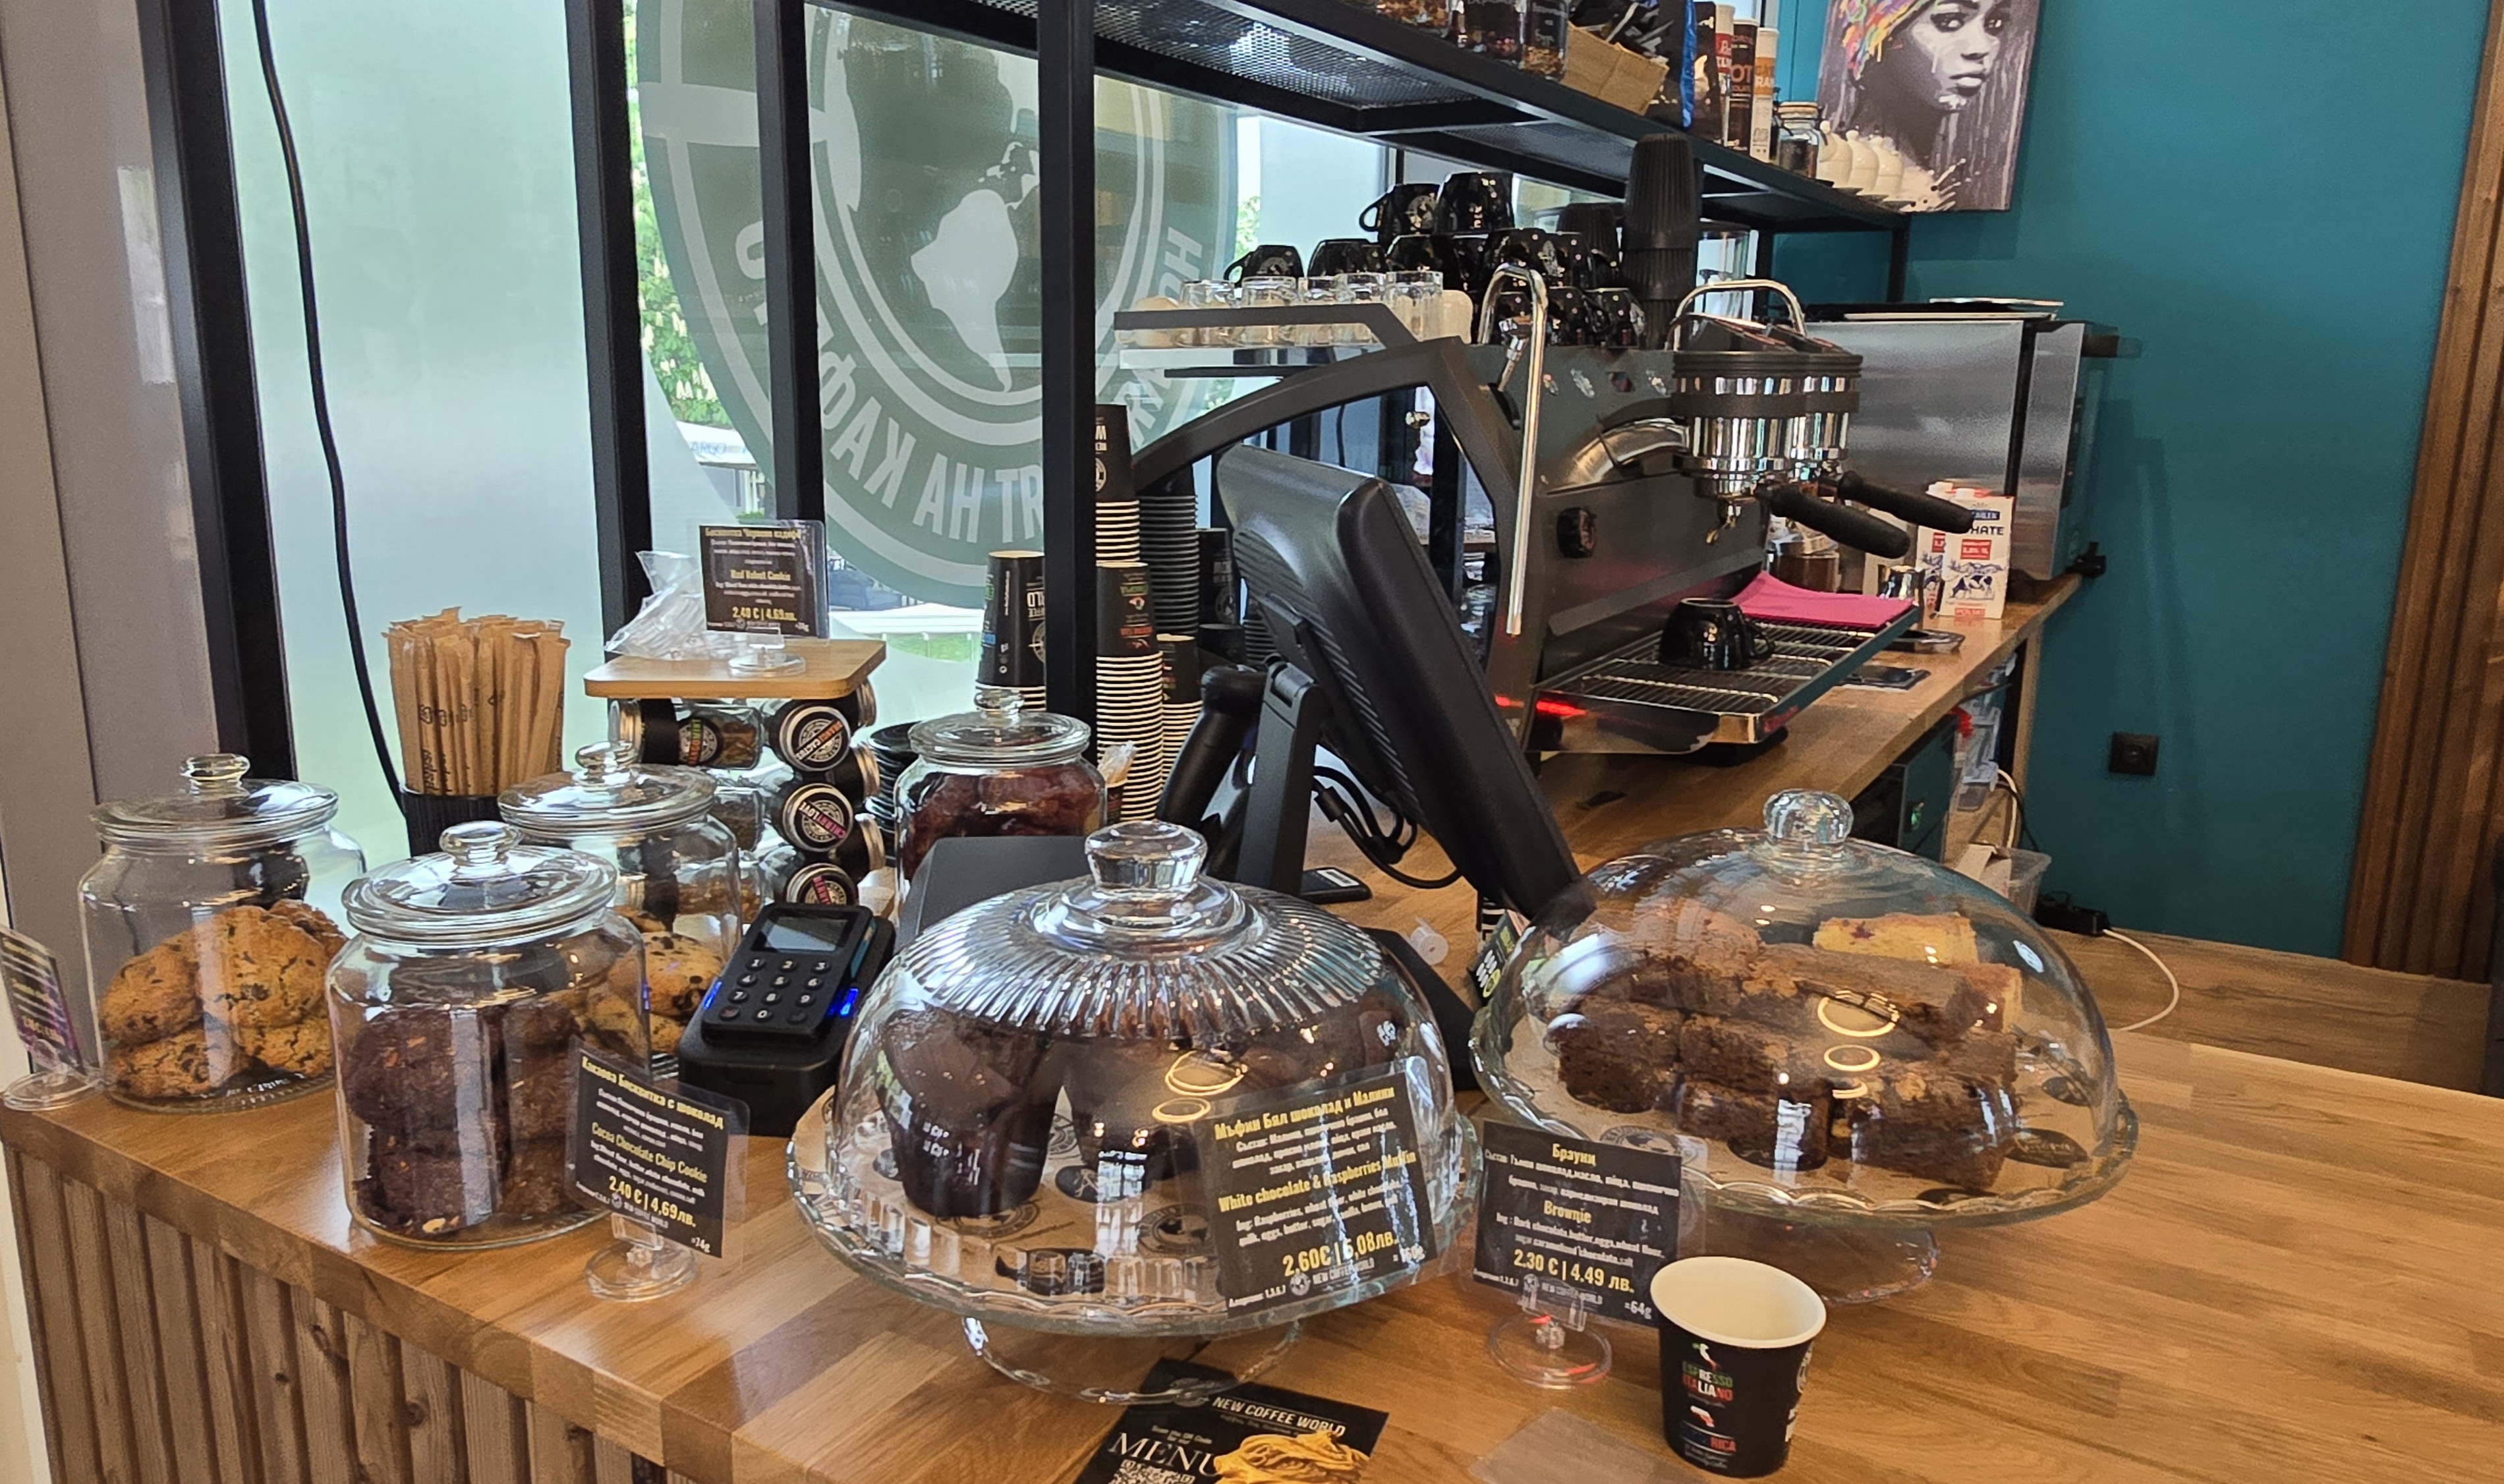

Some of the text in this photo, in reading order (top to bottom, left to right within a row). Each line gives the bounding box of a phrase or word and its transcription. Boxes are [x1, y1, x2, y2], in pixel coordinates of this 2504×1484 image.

[799, 801, 820, 822] LOVE
[774, 977, 783, 985] 5
[808, 978, 817, 986] 6
[766, 993, 776, 1002] 8
[800, 994, 810, 1004] 9
[757, 1010, 767, 1018] 0
[1214, 1118, 1261, 1141] Мъфин
[1263, 1110, 1288, 1128] Бял
[616, 1134, 654, 1162] Chocolate
[656, 1153, 675, 1172] Chip
[678, 1161, 706, 1183] Cookie
[1552, 1143, 1596, 1167] Брауни
[1219, 1193, 1253, 1212] White
[1255, 1180, 1310, 1203] chocolate
[1312, 1176, 1321, 1189] &
[1323, 1160, 1381, 1187] Raspberries
[1544, 1200, 1591, 1224] Brownie
[1514, 1249, 1544, 1271] 2.30
[1570, 1267, 1605, 1286] 4.49
[1608, 1276, 1635, 1293] лв.
[1212, 1396, 1245, 1412] NEW
[1245, 1405, 1295, 1425] COFFEE
[1297, 1416, 1346, 1437] WORLD
[1108, 1432, 1221, 1477] MENU
